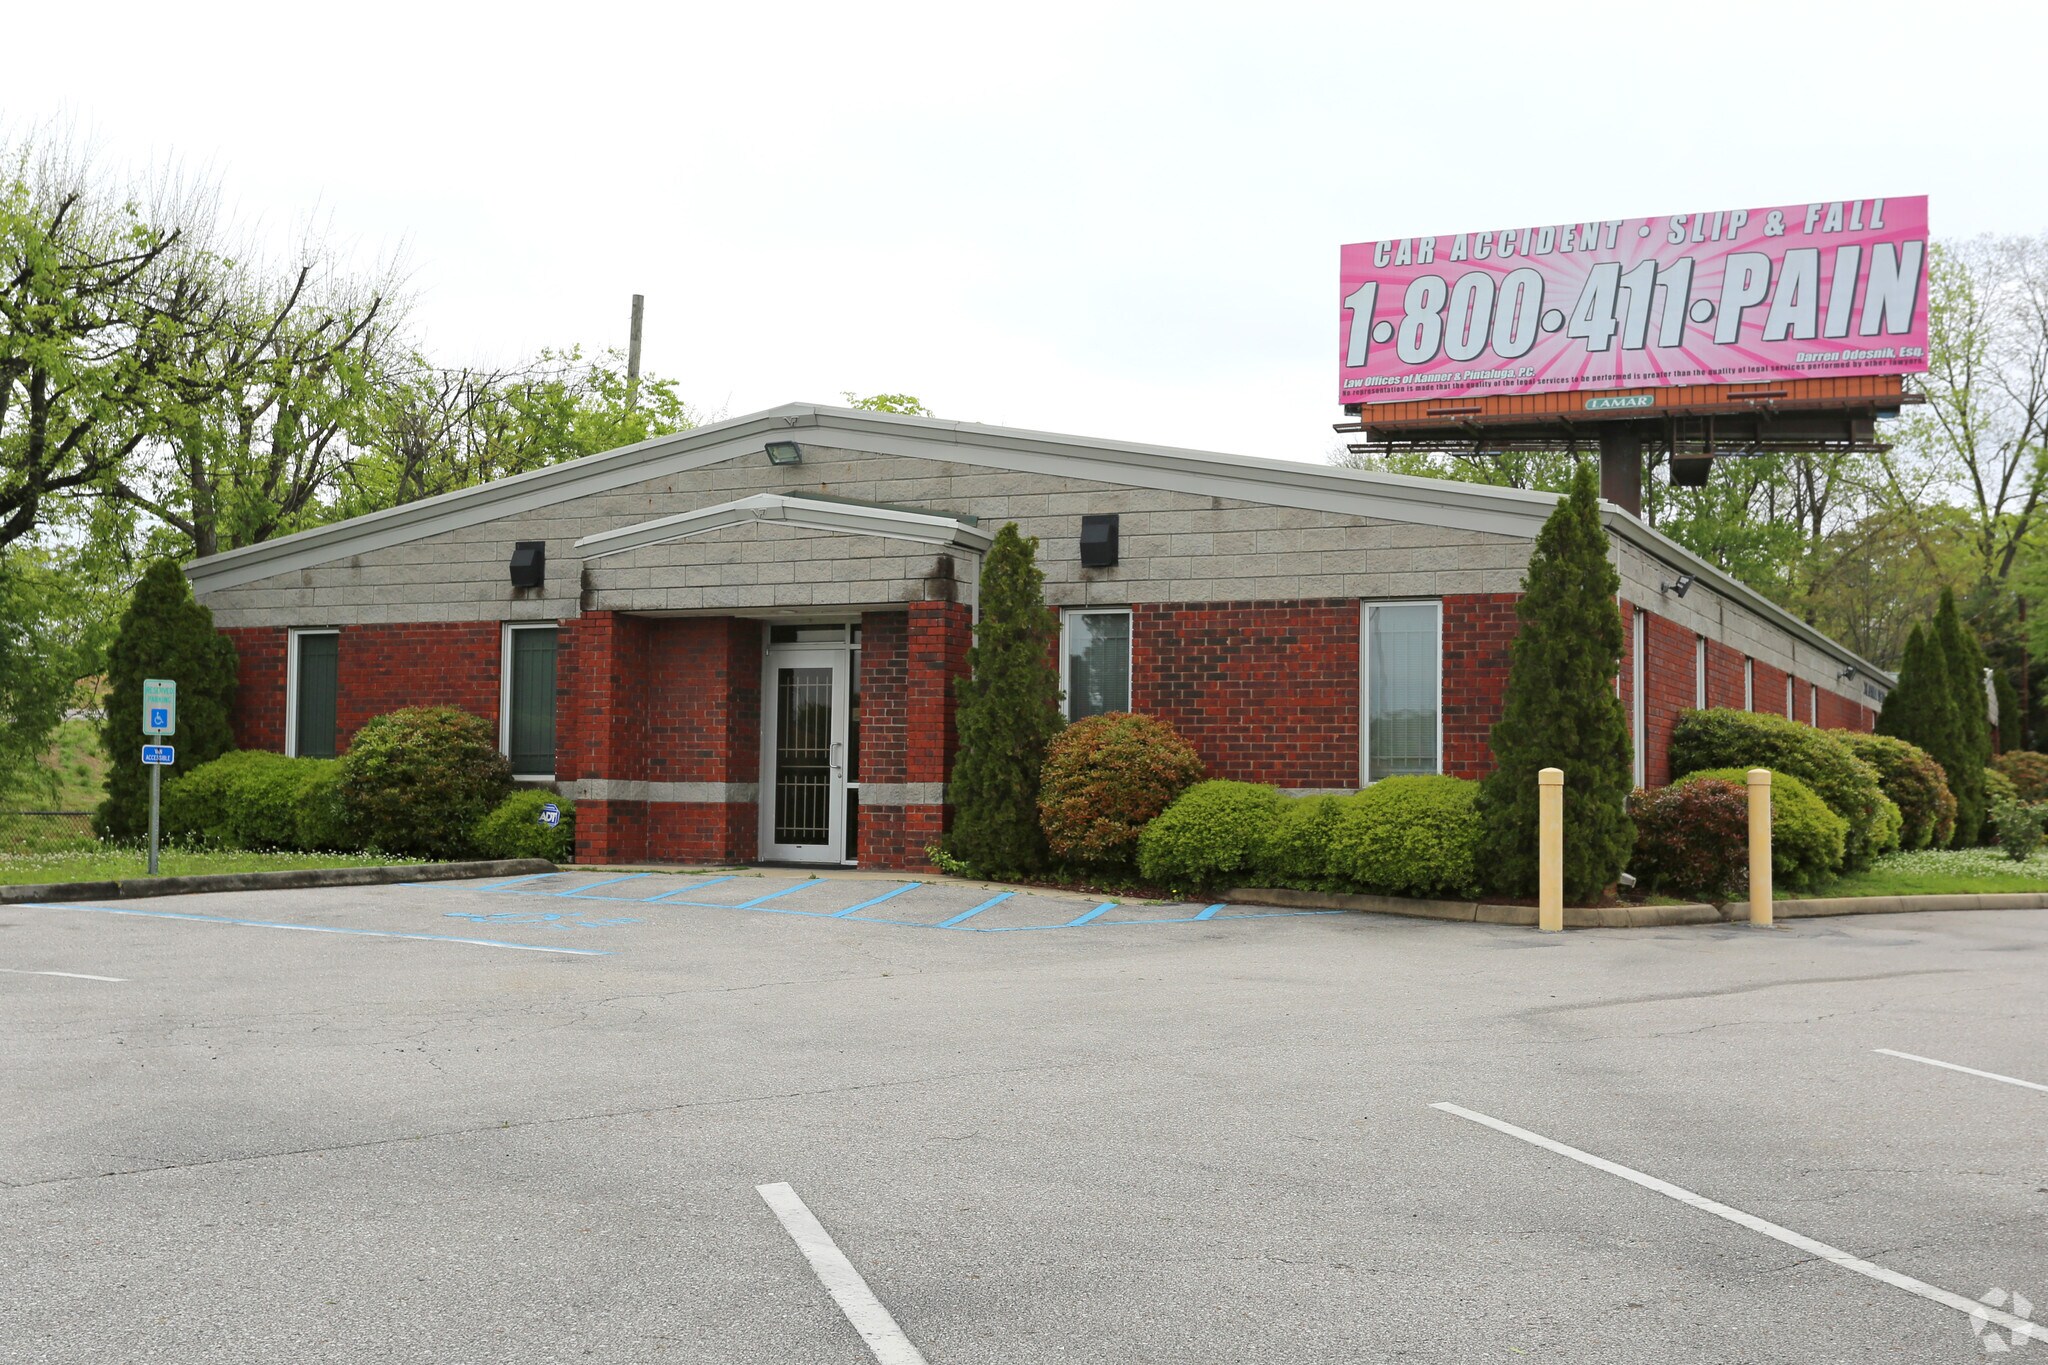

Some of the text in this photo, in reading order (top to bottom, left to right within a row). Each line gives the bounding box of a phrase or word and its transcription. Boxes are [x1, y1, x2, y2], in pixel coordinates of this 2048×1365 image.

[1373, 198, 1885, 268] CAR ACCIDENT SLIP & FALL
[1796, 352, 1840, 363] Darren
[1899, 346, 1925, 358] Esq.
[1343, 377, 1364, 389] Law
[1365, 374, 1401, 387] Offices
[1402, 372, 1412, 384] of
[1413, 371, 1452, 384] Kanner
[1454, 372, 1461, 382] &
[1517, 366, 1536, 377] P.C.
[1352, 386, 1405, 396] representation
[1466, 380, 1492, 389] quality
[1516, 377, 1535, 386] legal
[1537, 376, 1569, 385] services
[1581, 374, 1590, 382] be
[1592, 372, 1631, 382] performed
[1643, 370, 1671, 380] greater
[1673, 369, 1691, 377] than
[1693, 368, 1706, 376] the
[1707, 367, 1736, 376] quality
[1747, 364, 1768, 373] legal
[1770, 363, 1805, 371] services
[1807, 361, 1850, 370] performed
[1852, 360, 1862, 368] by
[1865, 359, 1887, 367] other
[1590, 396, 1648, 408] LAMAR
[145, 754, 171, 762] ACCESSIBLE
[539, 811, 558, 823] ADT
